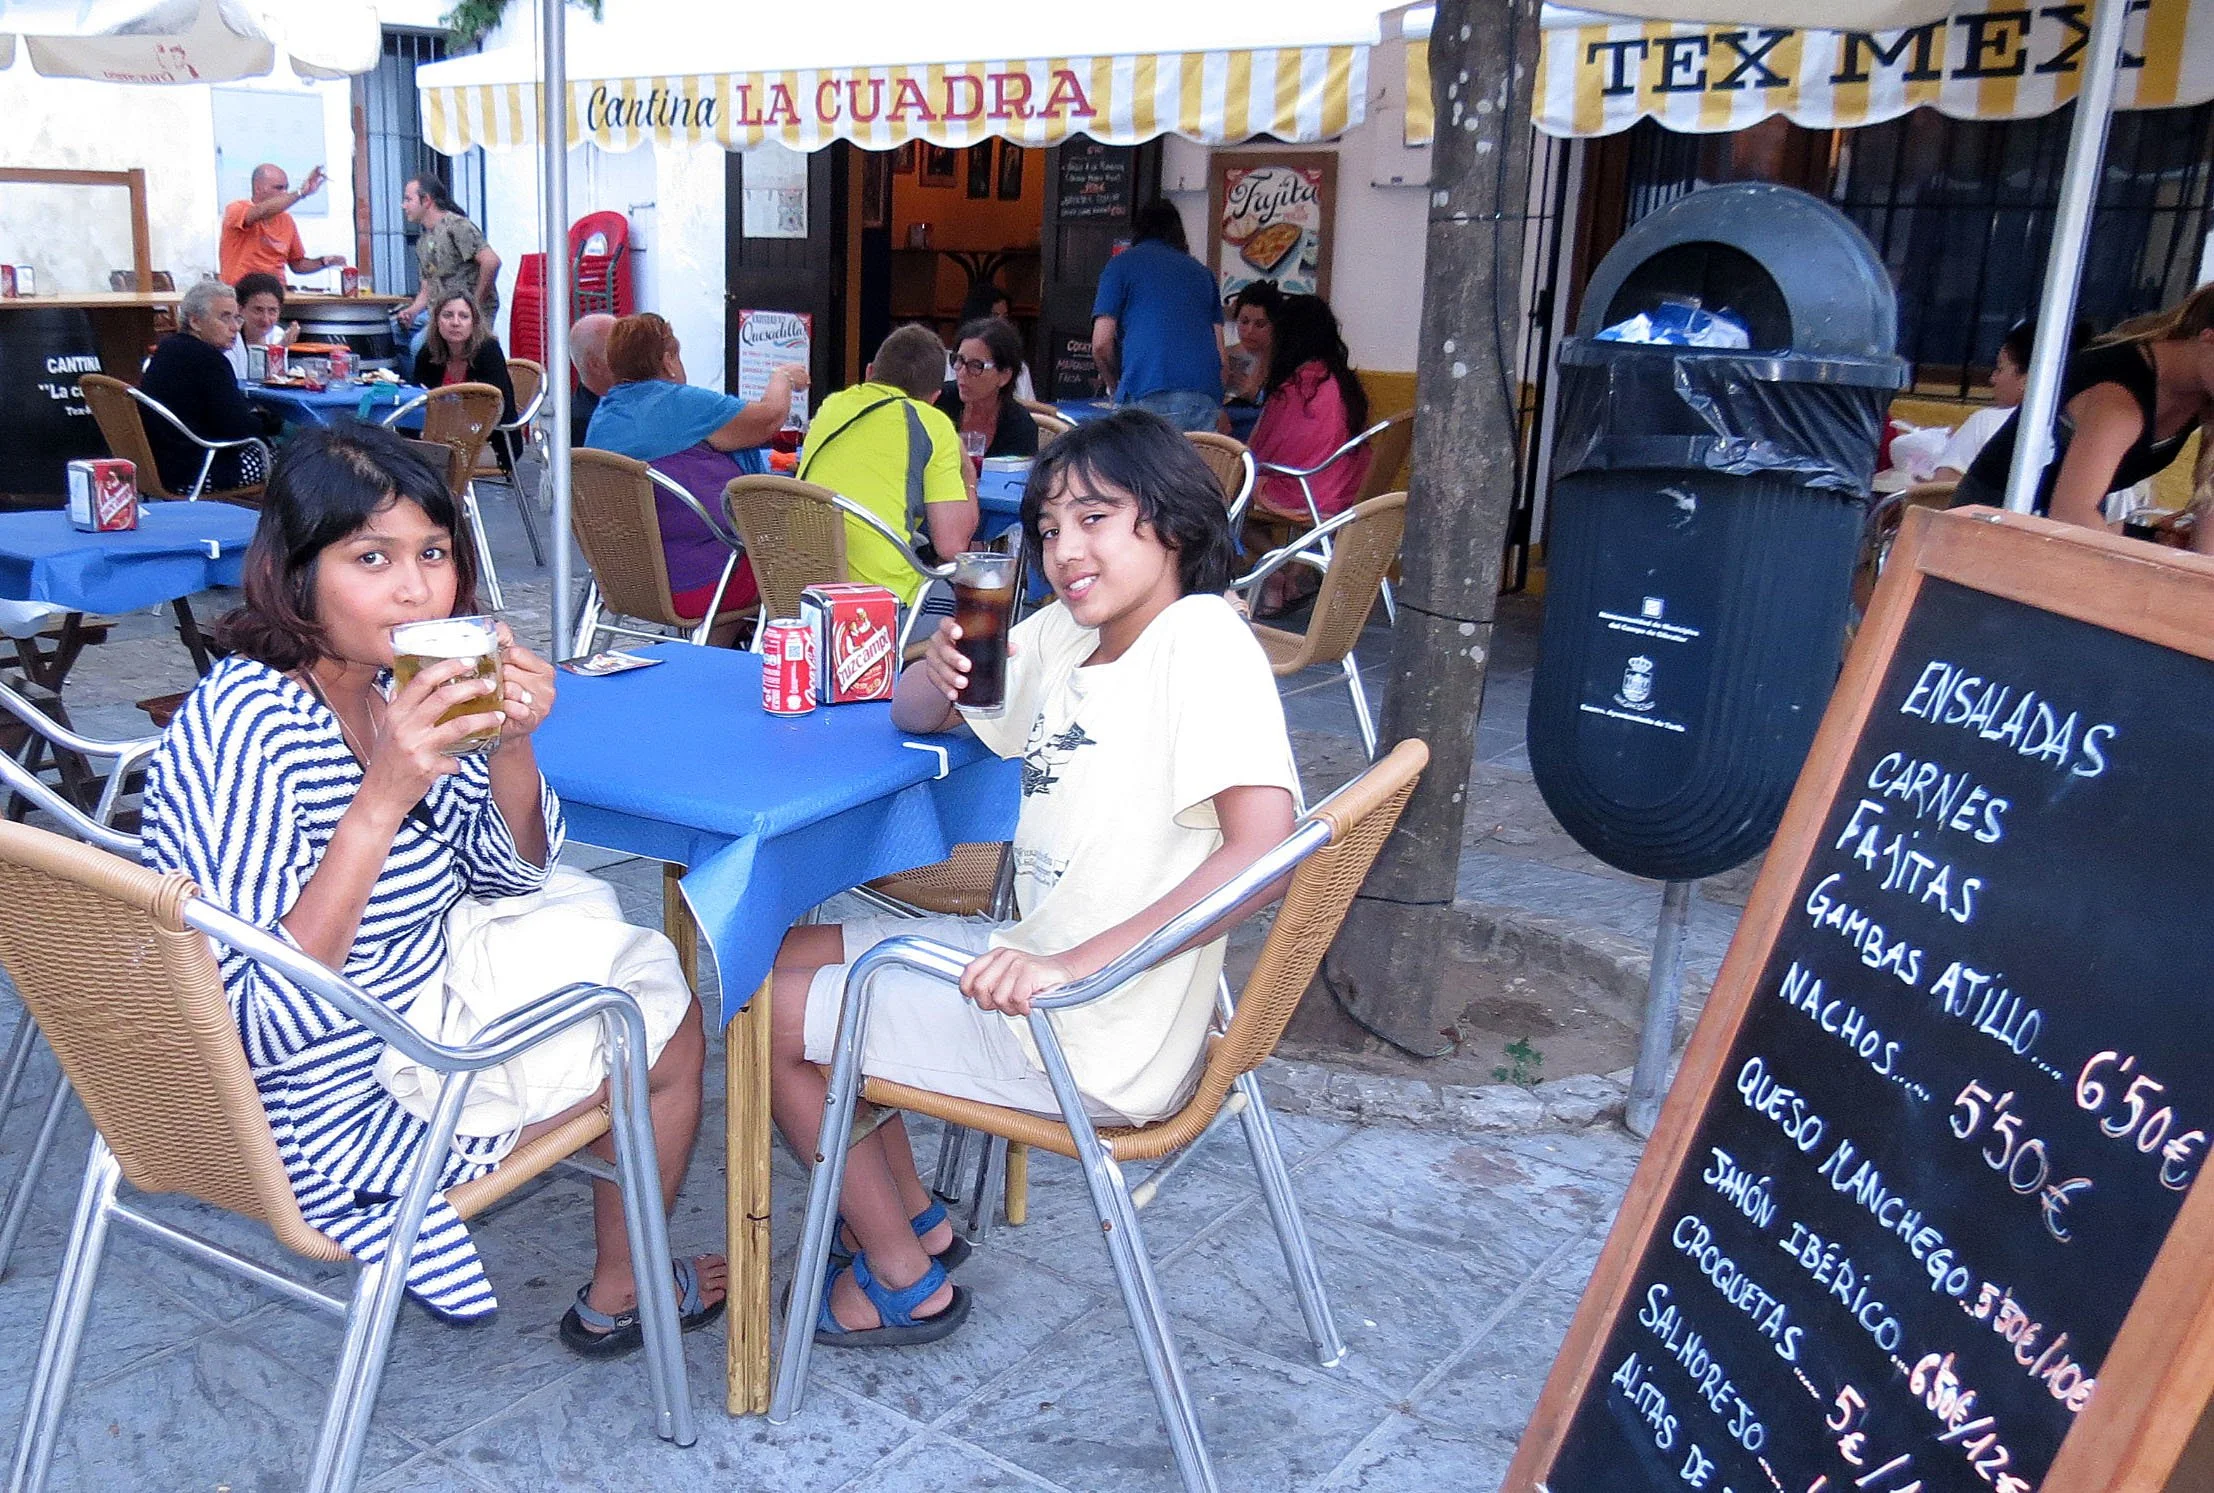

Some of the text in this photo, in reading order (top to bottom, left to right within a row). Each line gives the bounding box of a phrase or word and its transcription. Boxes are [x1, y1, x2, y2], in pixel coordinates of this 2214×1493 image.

[588, 70, 1098, 131] Cantina LA CUADRA
[1586, 29, 1794, 96] TEX
[46, 356, 103, 374] CANTINA
[1900, 660, 2116, 777] ENSALADAS
[1867, 752, 2008, 843] CARNES
[1806, 873, 1922, 985] GAMBAS
[1737, 1057, 1823, 1151] QUESO
[1703, 1147, 1777, 1228] JAMÓN
[1680, 1443, 1715, 1488] DE
